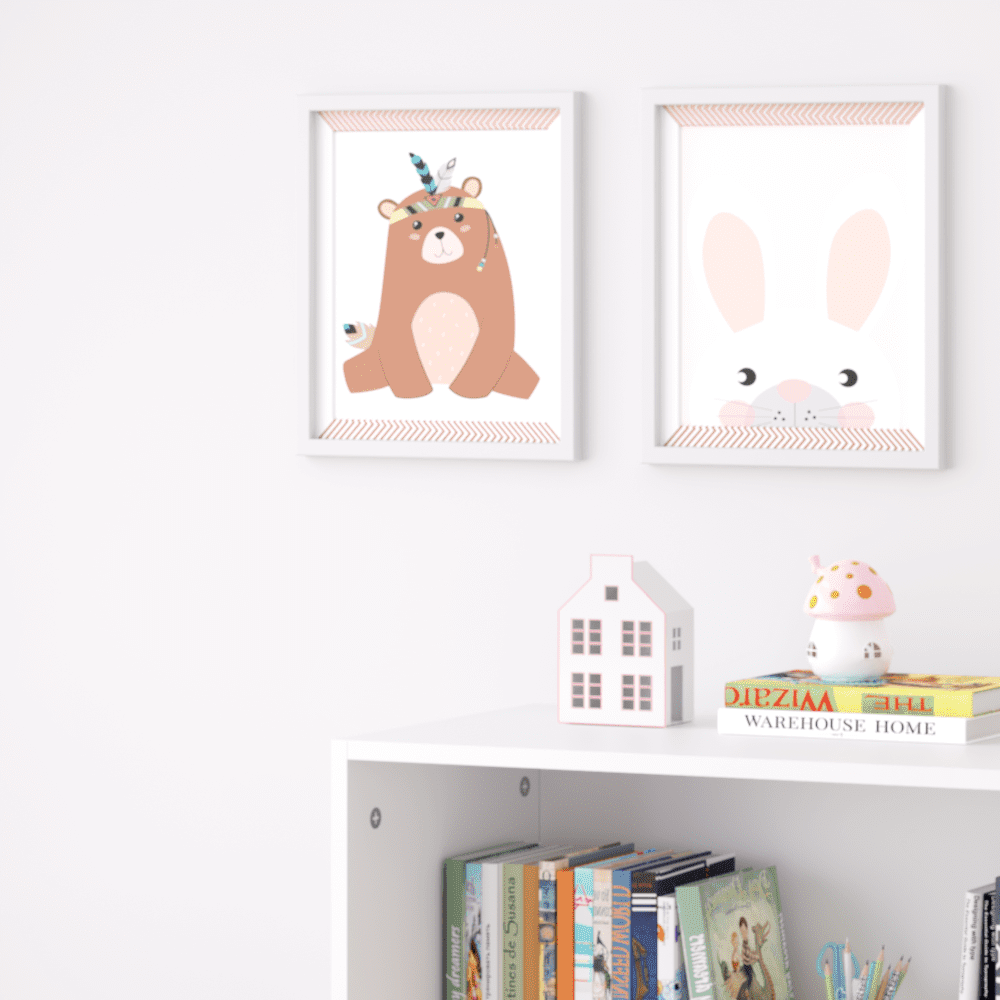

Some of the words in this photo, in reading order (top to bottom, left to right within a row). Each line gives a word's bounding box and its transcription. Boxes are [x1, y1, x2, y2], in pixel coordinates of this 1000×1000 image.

[864, 694, 934, 712] THE
[745, 714, 866, 733] WAREHOUSE
[875, 720, 936, 736] HOME
[503, 876, 519, 936] Susana
[970, 895, 980, 929] Designing
[446, 925, 460, 988] dreamers
[503, 941, 516, 959] de
